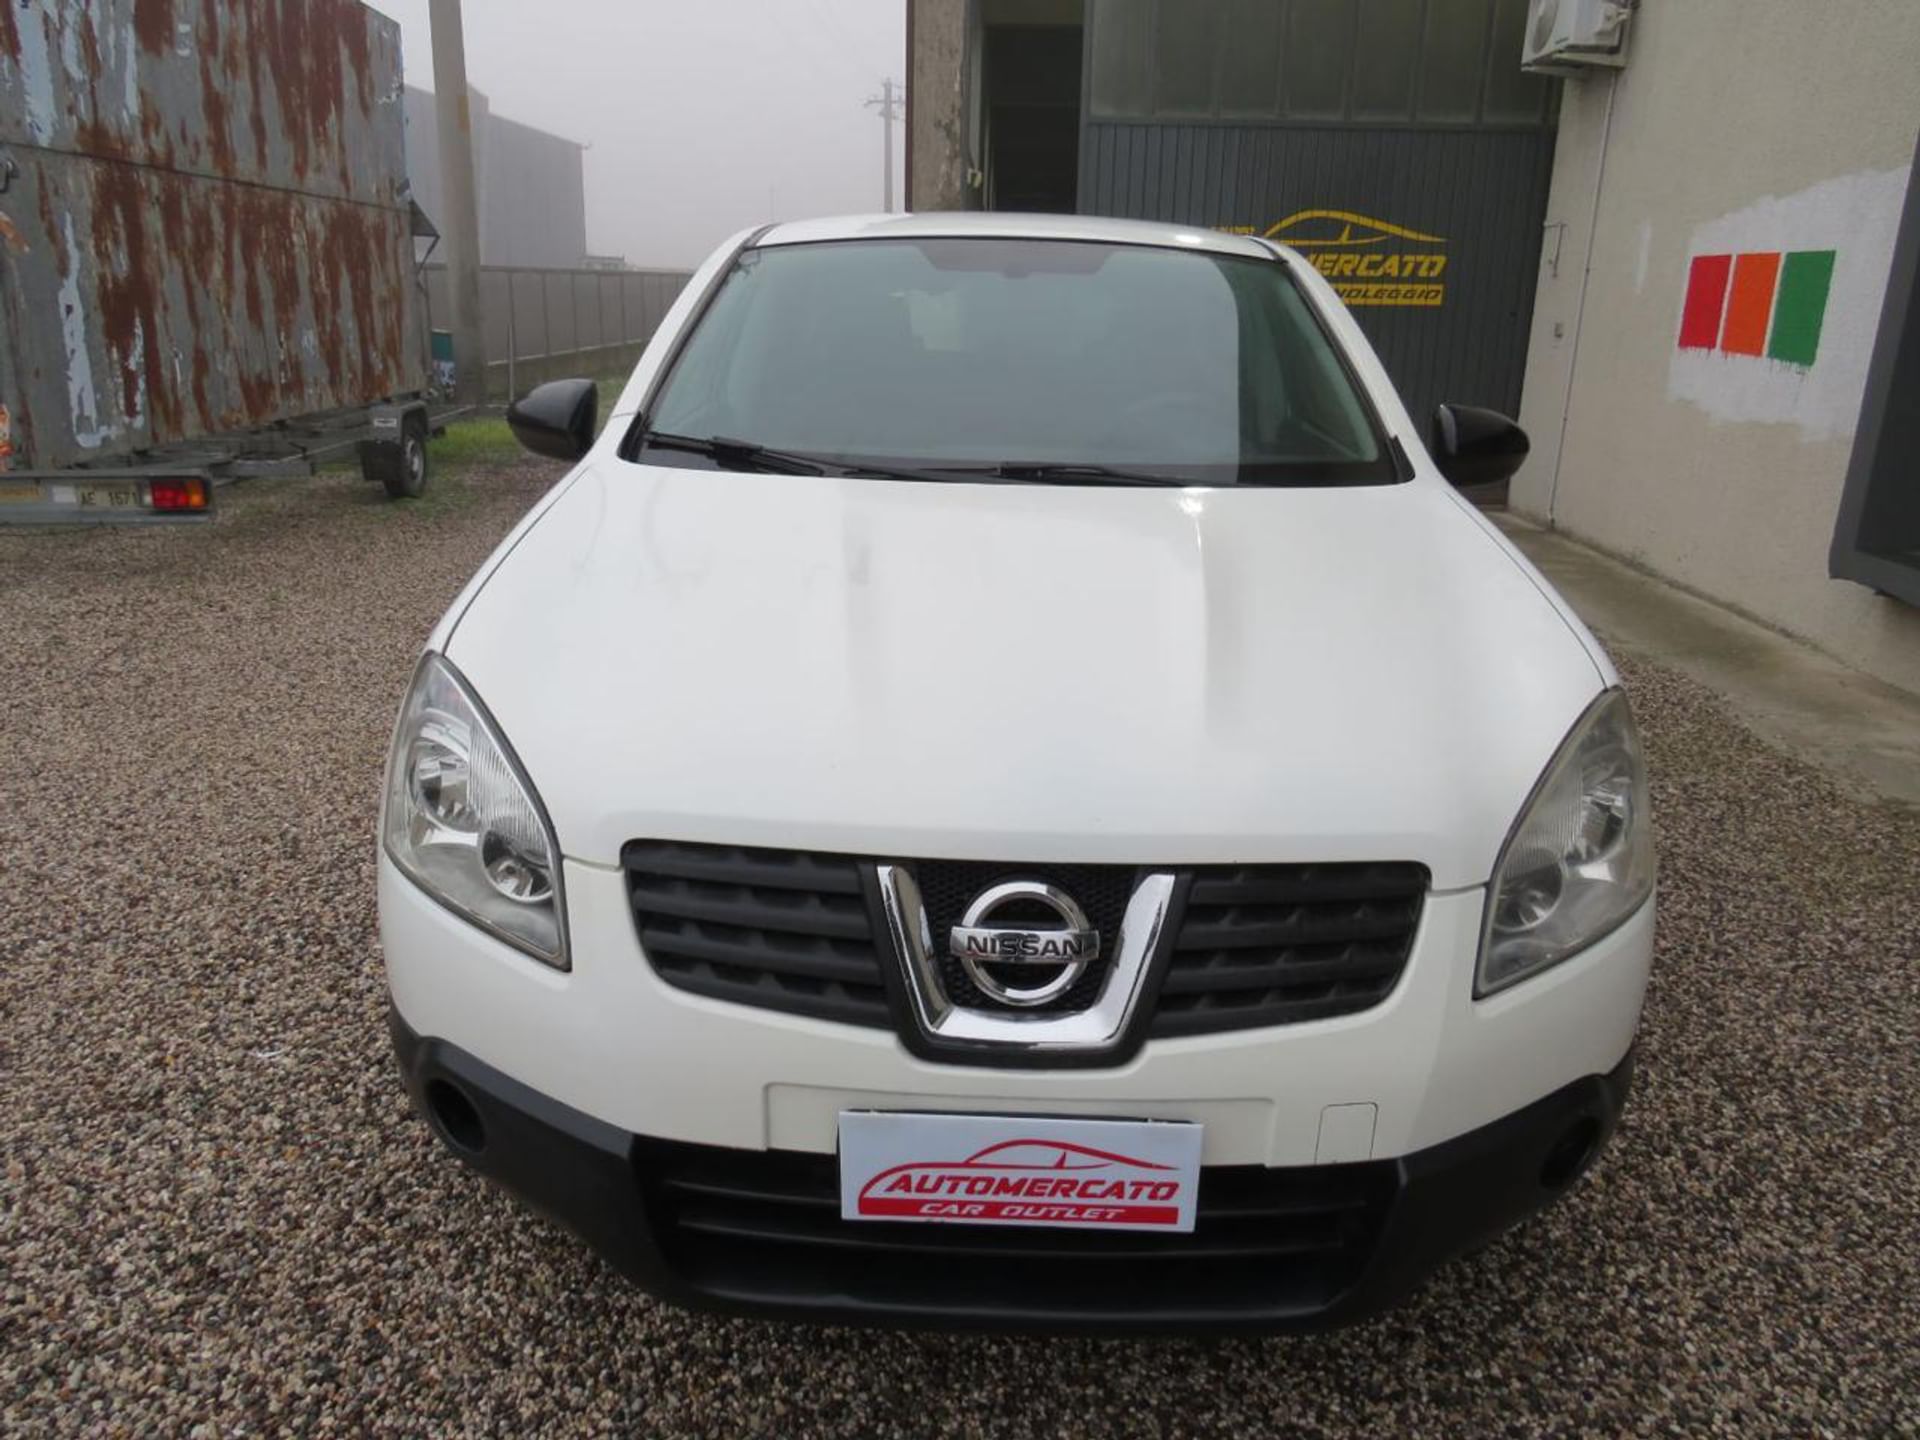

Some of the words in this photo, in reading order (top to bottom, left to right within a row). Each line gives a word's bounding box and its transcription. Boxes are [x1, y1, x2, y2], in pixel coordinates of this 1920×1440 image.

[967, 935, 1083, 956] NISSAN
[884, 1174, 1180, 1200] AUTOMERCATO
[919, 1202, 985, 1216] CAR
[1000, 1205, 1126, 1219] OUTLET
